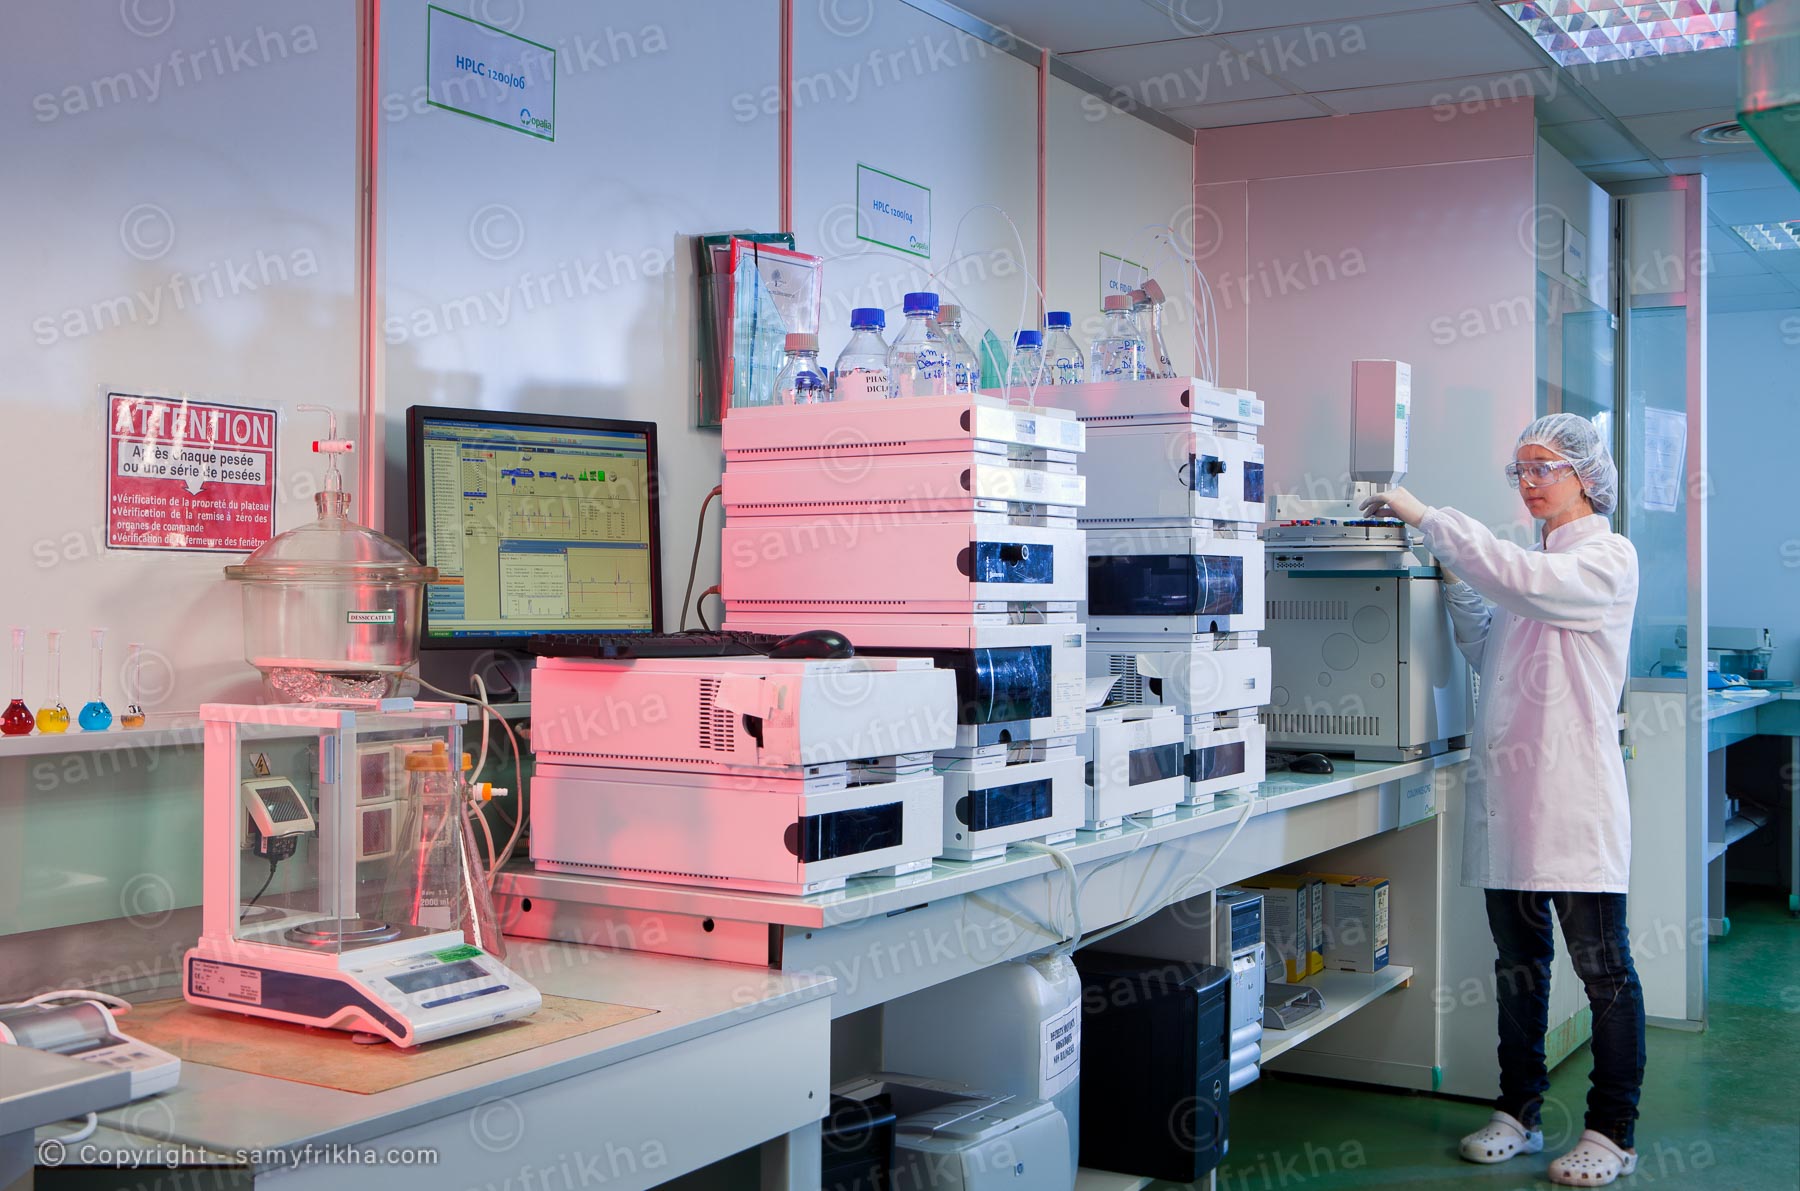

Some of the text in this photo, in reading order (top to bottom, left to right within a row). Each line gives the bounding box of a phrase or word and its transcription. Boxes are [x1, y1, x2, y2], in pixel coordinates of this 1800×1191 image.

[456, 55, 525, 89] HPLC 1200/06
[531, 117, 551, 130] opalia
[873, 200, 913, 224] HPLC 1200/04
[115, 402, 269, 446] ATTENTION
[132, 445, 169, 461] Apès
[220, 453, 254, 467] pesée
[123, 462, 139, 473] ou
[144, 463, 166, 475] une
[170, 463, 199, 477] série
[221, 468, 262, 482] pesées
[117, 493, 269, 512] Vérification de la propreté du plateau
[117, 506, 268, 523] Vérification de la remise à zéro des
[117, 522, 204, 533] organes de commande
[117, 532, 162, 543] Vérification
[164, 534, 174, 545] d
[224, 537, 238, 546] des
[239, 537, 267, 547] fenêtre
